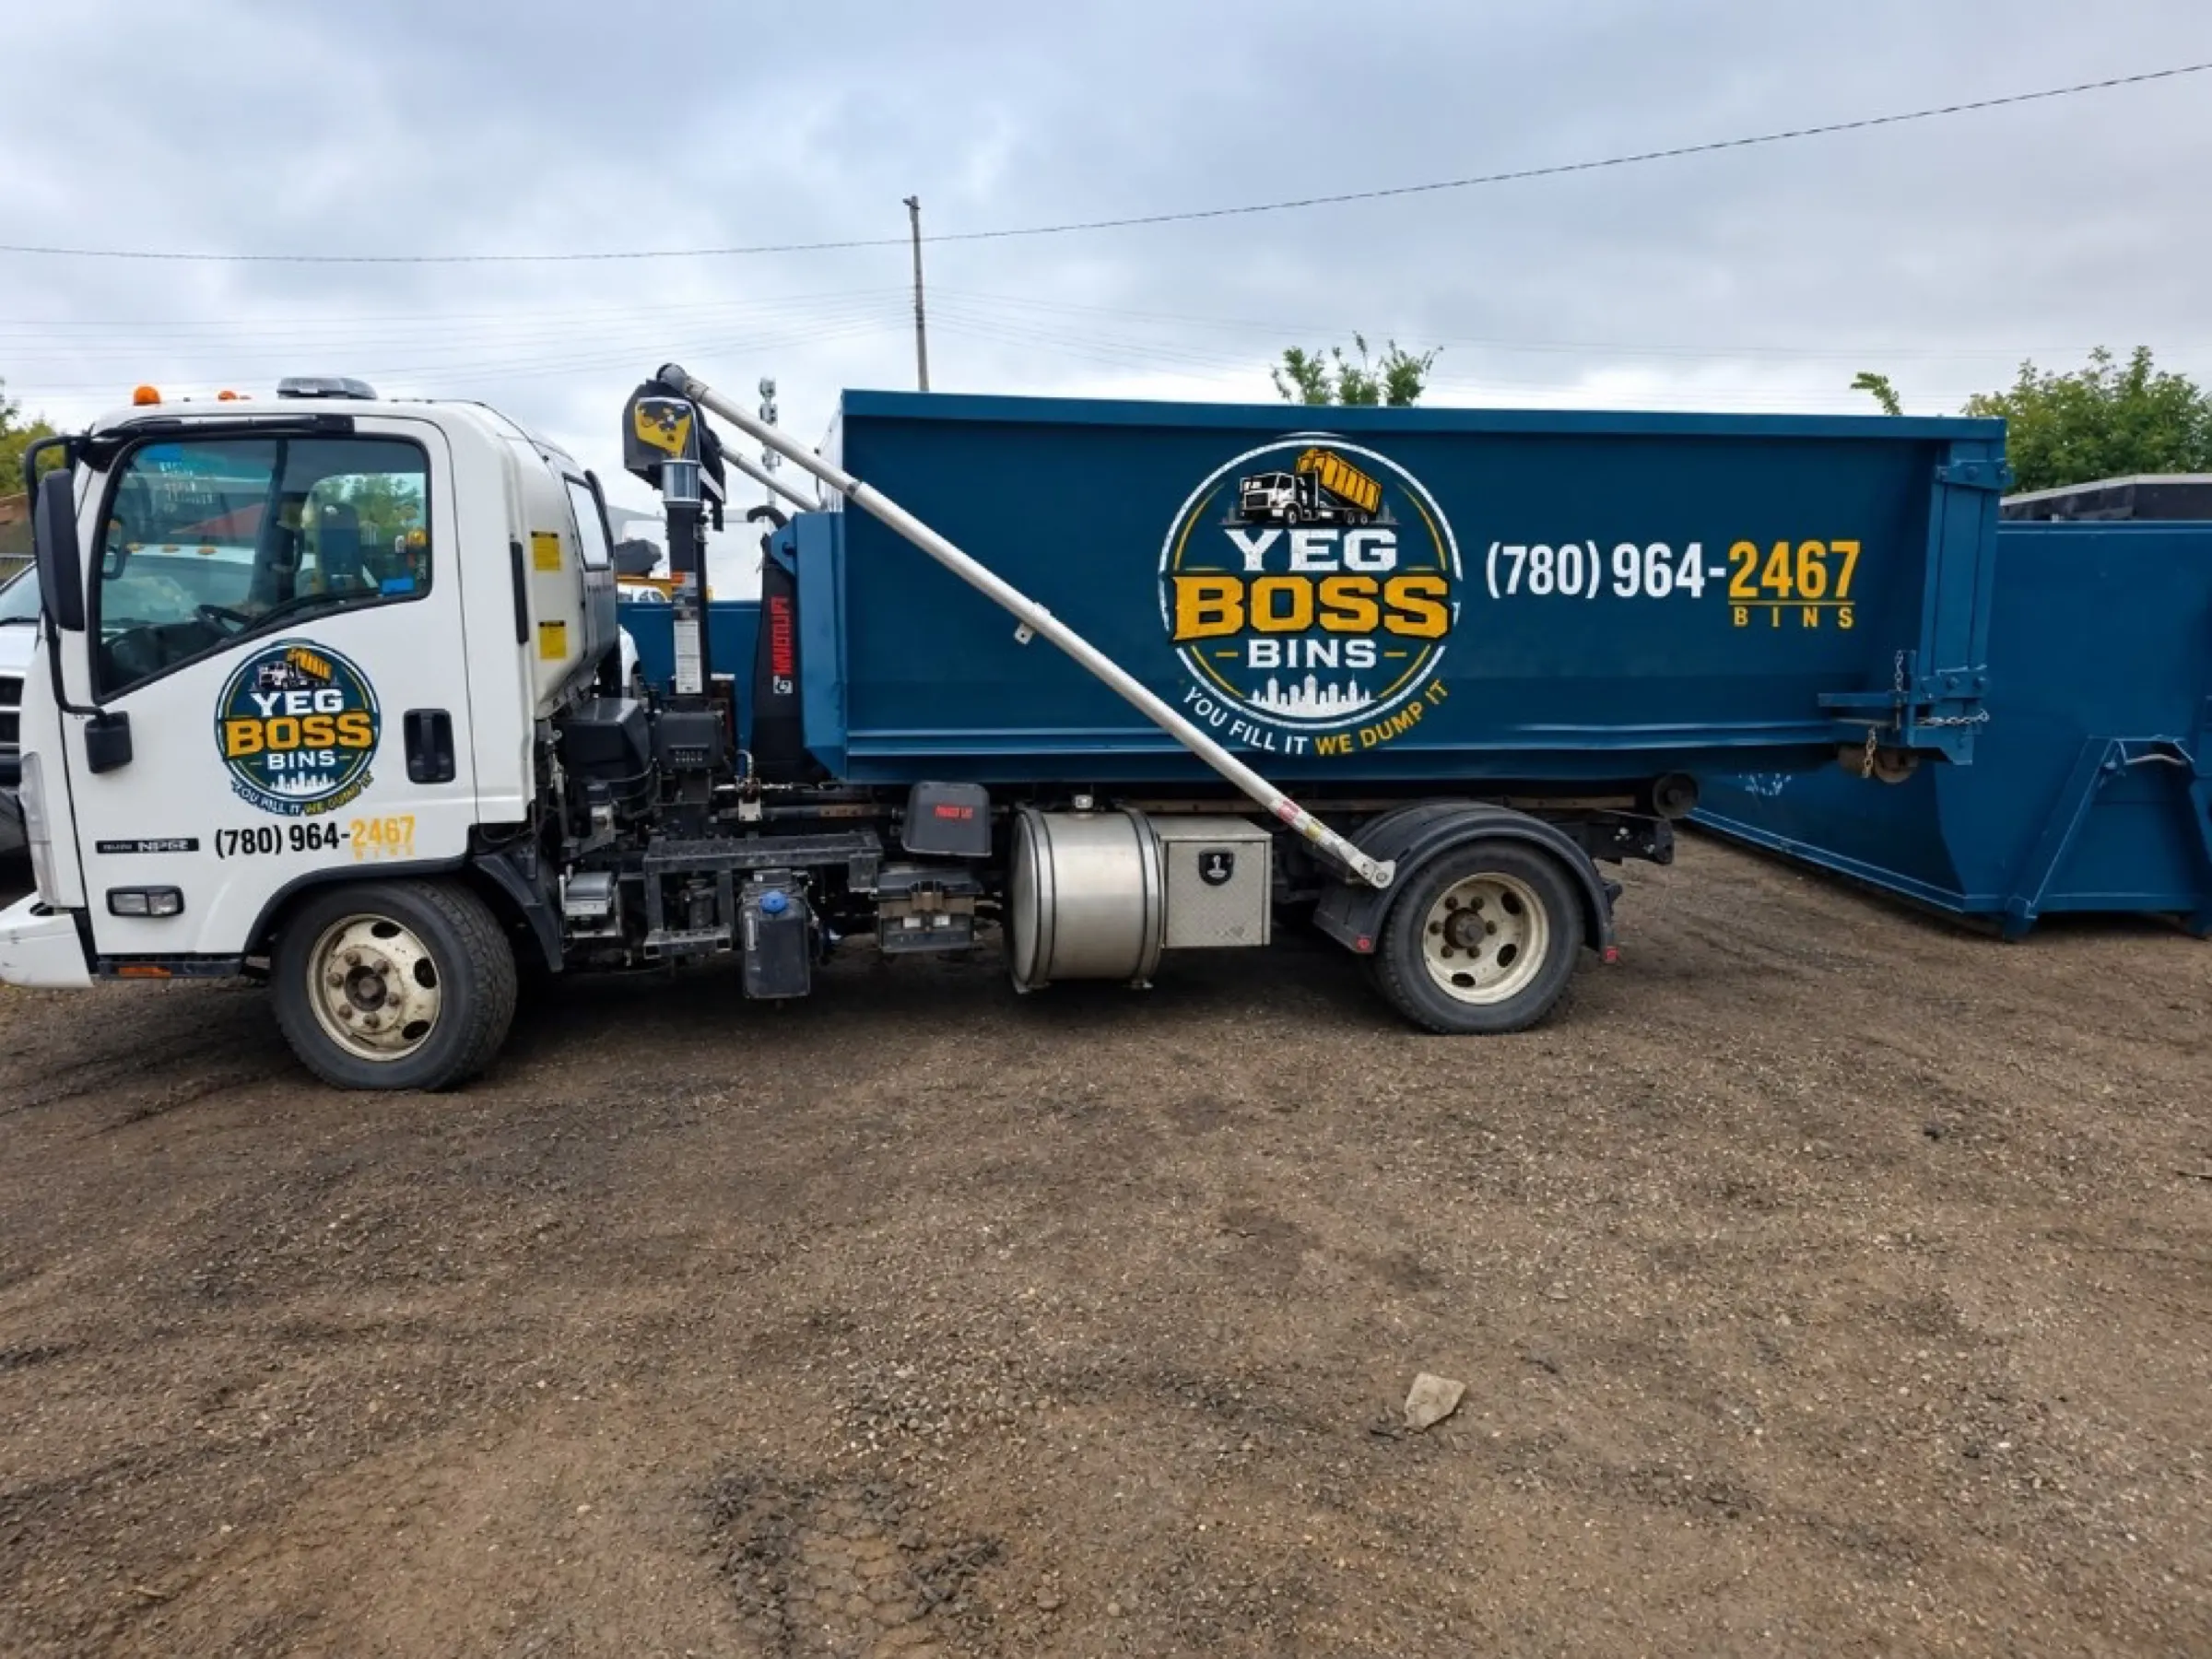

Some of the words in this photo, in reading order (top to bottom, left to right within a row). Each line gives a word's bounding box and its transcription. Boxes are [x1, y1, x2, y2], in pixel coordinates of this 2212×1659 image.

[1225, 528, 1397, 571] YEG
[1486, 540, 1601, 598] (780)
[1611, 540, 1861, 598] 964-2467
[1172, 576, 1448, 640] BOSS
[1734, 606, 1854, 629] BINS
[1247, 639, 1377, 668] BINS
[251, 688, 344, 717] YEG
[1182, 686, 1228, 727] YOU
[1229, 719, 1277, 751] FILL
[1285, 735, 1309, 755] IT
[1314, 734, 1353, 756] WE
[1359, 702, 1425, 748] DUMP
[1425, 678, 1450, 704] IT
[225, 712, 371, 757] BOSS
[267, 750, 335, 770] BINS
[215, 825, 282, 859] (780)
[288, 815, 415, 852] 964-2467
